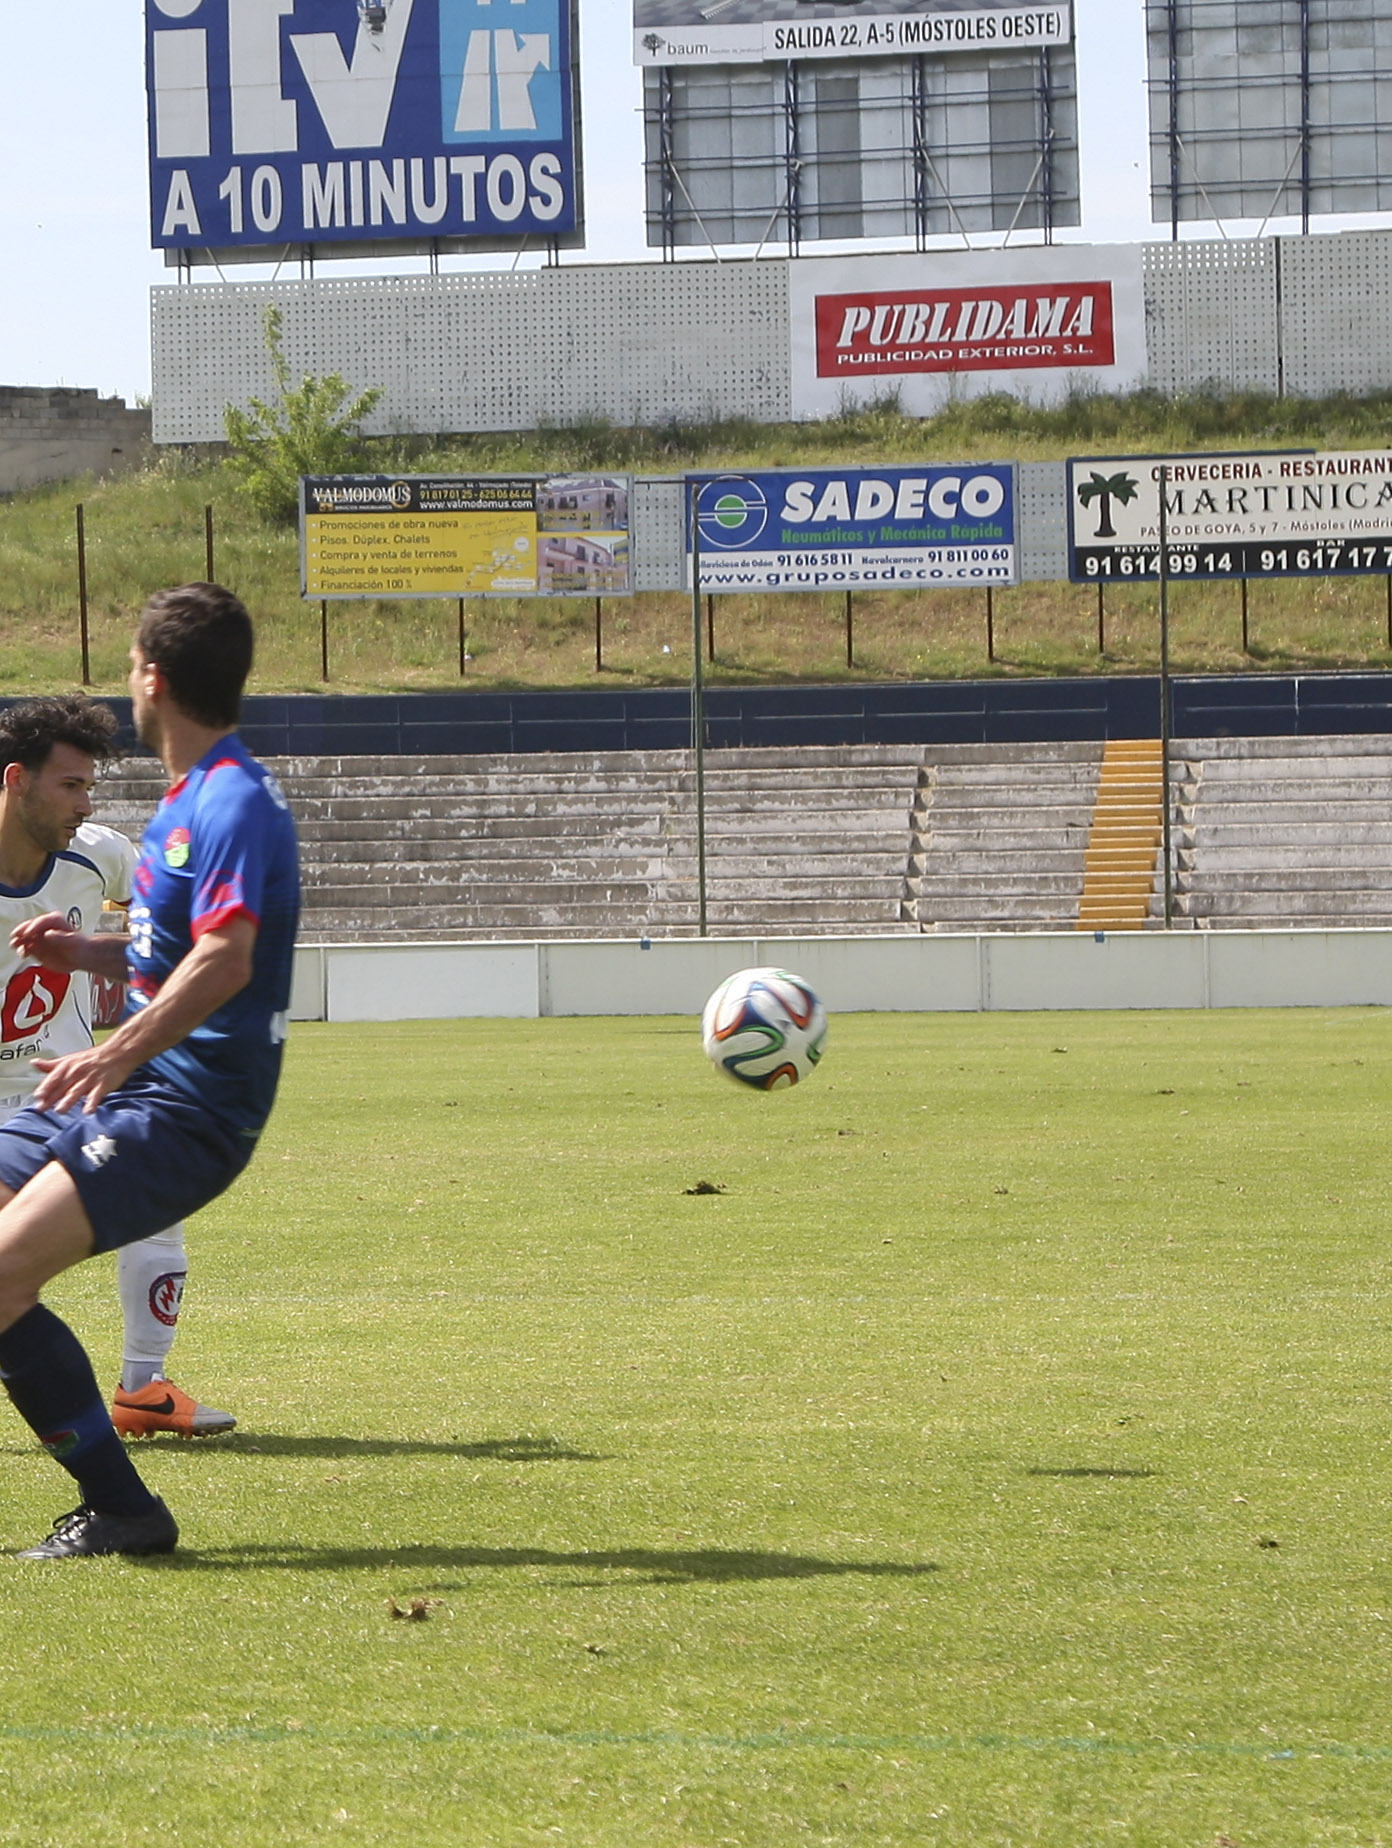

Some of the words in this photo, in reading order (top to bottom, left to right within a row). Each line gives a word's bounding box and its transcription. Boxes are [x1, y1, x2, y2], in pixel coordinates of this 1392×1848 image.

[774, 22, 836, 50] SALIDA
[840, 24, 863, 47] 22,
[867, 22, 895, 44] A-5
[899, 14, 996, 46] (MÓSTOLES
[1002, 11, 1061, 38] OESTE)
[668, 43, 708, 55] baum
[162, 170, 201, 236] A
[219, 165, 282, 233] 10
[302, 153, 564, 229] MINUTOS
[836, 296, 1095, 348] PUBLIDAMA
[837, 350, 953, 366] PUBLICIDAD
[959, 345, 1057, 359] EXTERIOR,
[1063, 343, 1094, 355] S.L.
[1151, 463, 1262, 482] CERVECERIA
[313, 485, 411, 503] VALMODOMUS
[780, 475, 1005, 523] SADECO
[419, 498, 533, 509] www.valmodomus.com
[320, 520, 385, 530] Promociones
[388, 520, 400, 529] de
[403, 519, 426, 529] obra
[429, 520, 459, 529] nueva
[781, 527, 863, 544] Neumáticos
[868, 530, 876, 544] y
[880, 523, 946, 540] Mecánica
[951, 523, 1003, 541] Rápida
[1185, 526, 1200, 536] DE
[1205, 524, 1245, 536] GOYA,
[1249, 524, 1256, 533] 5
[1260, 525, 1266, 535] y
[1272, 522, 1278, 532] 7
[1291, 519, 1345, 532] Móstoles
[394, 534, 431, 544] Chalets
[1317, 539, 1346, 547] BAR
[320, 551, 359, 560] Compra
[371, 550, 397, 559] venta
[400, 549, 412, 558] de
[415, 549, 457, 559] terrenos
[1114, 544, 1200, 553] RESTAUANTE
[777, 554, 790, 567] 91
[795, 554, 818, 566] 616
[821, 553, 838, 565] 58
[841, 553, 852, 565] 11
[928, 551, 942, 563] 91
[947, 550, 968, 562] 811
[972, 549, 988, 561] 00
[992, 549, 1008, 560] 60
[1086, 556, 1111, 576] 91
[1120, 555, 1160, 575] 614
[1169, 554, 1197, 573] 99
[1204, 552, 1232, 572] 14
[1261, 550, 1287, 570] 91
[1296, 549, 1341, 570] 617
[1348, 547, 1376, 567] 17
[368, 565, 379, 574] de
[381, 565, 412, 574] locales
[422, 564, 464, 574] viviendas
[699, 566, 1009, 586] www.gruposadeco.com
[387, 579, 403, 589] 100
